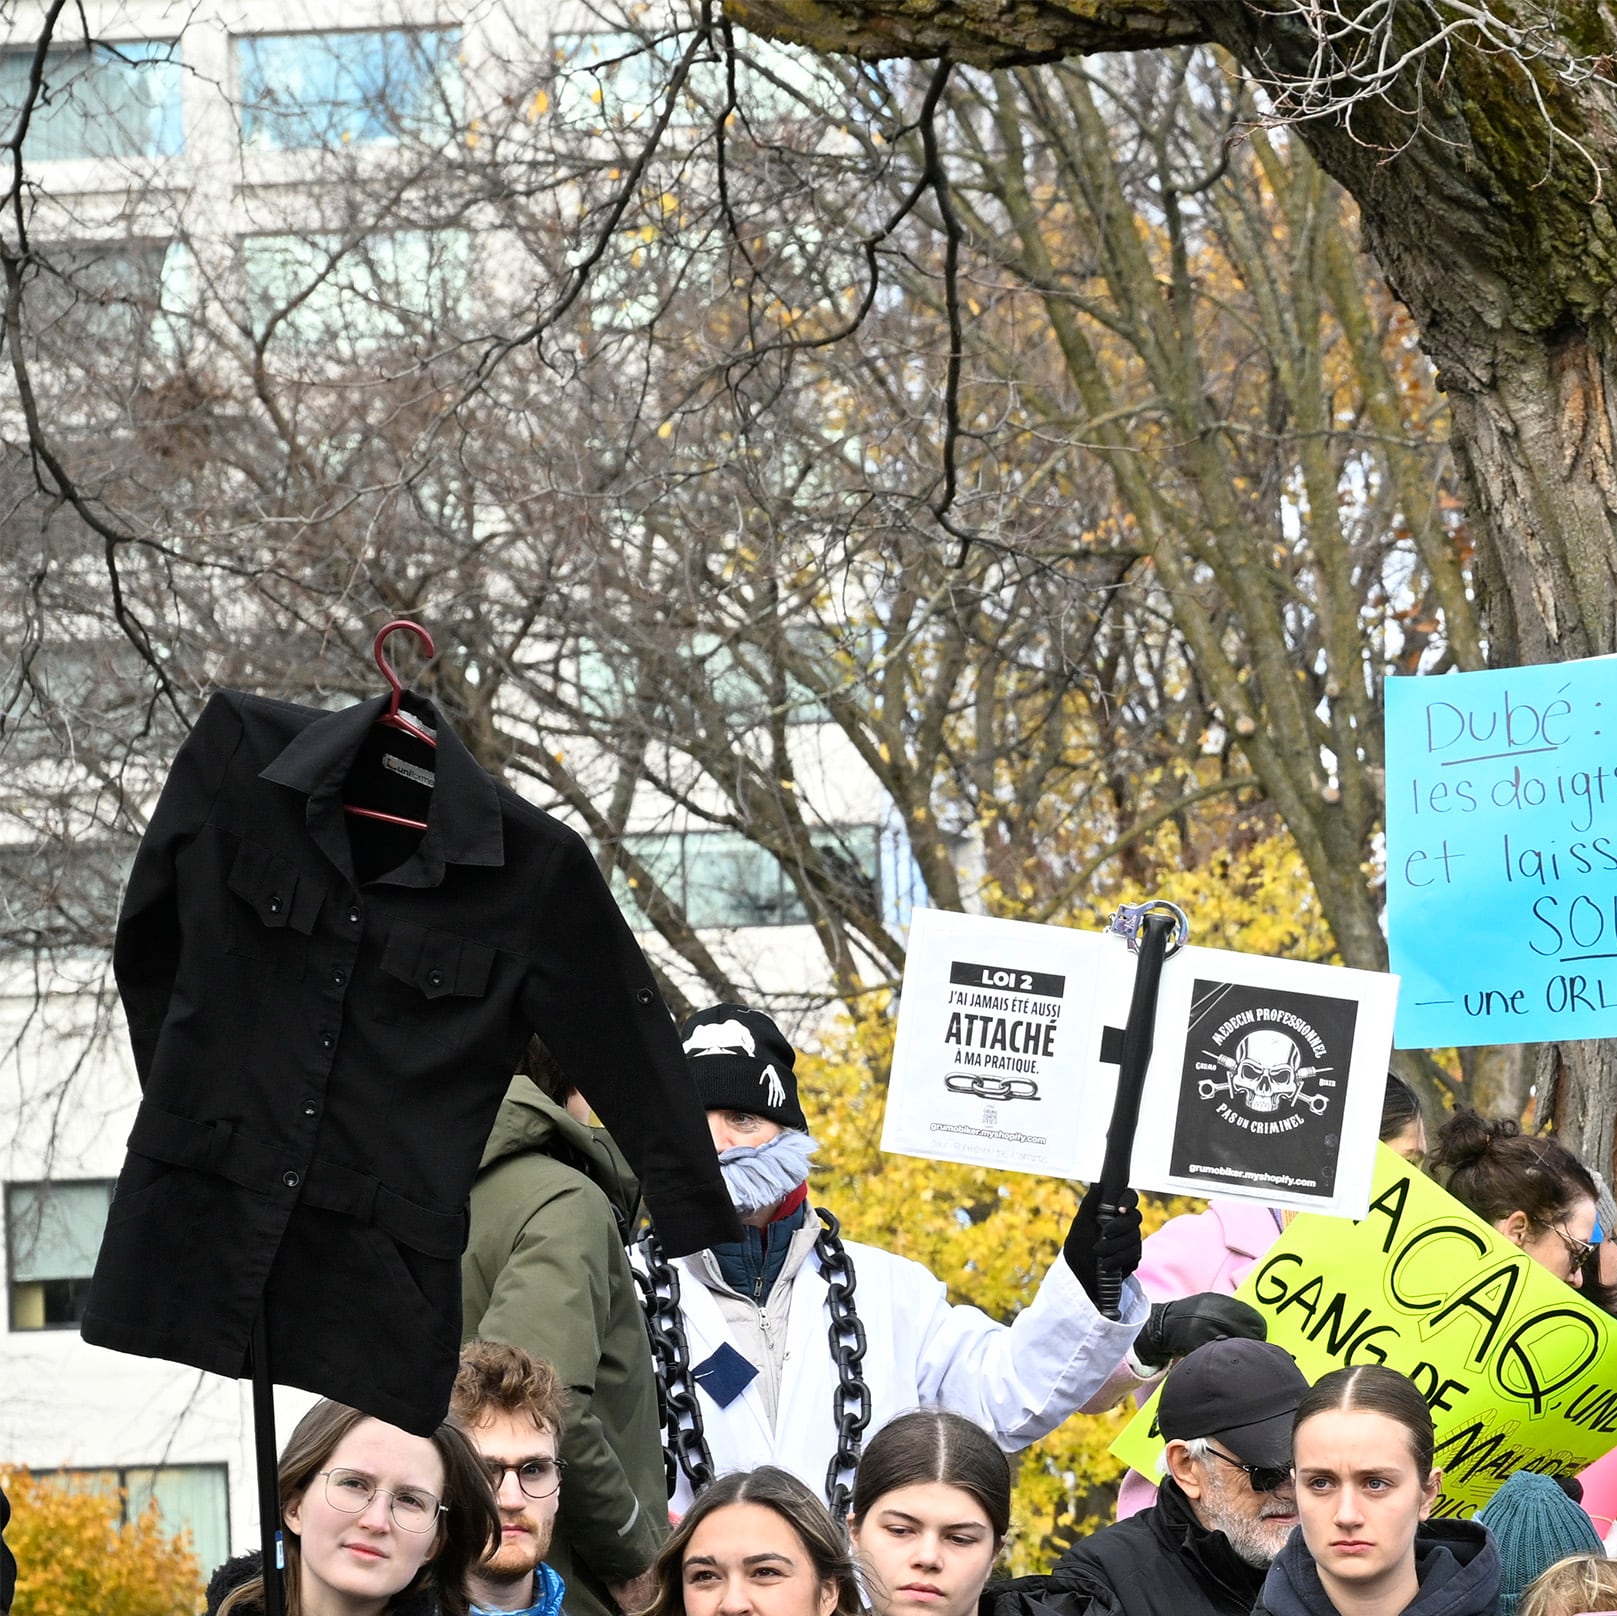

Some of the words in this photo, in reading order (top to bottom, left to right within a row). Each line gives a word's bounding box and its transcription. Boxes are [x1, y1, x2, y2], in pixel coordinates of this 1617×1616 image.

[1425, 681, 1573, 753] Dubé
[1411, 778, 1478, 815] les
[1403, 839, 1466, 887] et
[982, 969, 1016, 988] LOI
[1020, 974, 1033, 991] 2
[969, 993, 1009, 1012] JAMAIS
[1011, 996, 1029, 1014] ÉTÉ
[1031, 1001, 1061, 1018] AUSSI
[1463, 988, 1526, 1018] une
[944, 1011, 1057, 1057] ATTACHÉ
[1211, 1009, 1255, 1047] MEDECIN
[1255, 1008, 1328, 1060] PROFESSIONNEL
[954, 1047, 962, 1064] À
[964, 1051, 982, 1067] MA
[984, 1054, 1039, 1075] PRATIQUE.
[930, 1122, 1047, 1145] grumobiker.myshopify.com
[1215, 1102, 1238, 1125] PAS
[1236, 1116, 1250, 1129] UN
[1250, 1113, 1305, 1135] CRIMINEL
[1188, 1163, 1317, 1188] grumobiker.myshopify.com
[1255, 1252, 1402, 1370] GANG
[1408, 1361, 1470, 1412] DE
